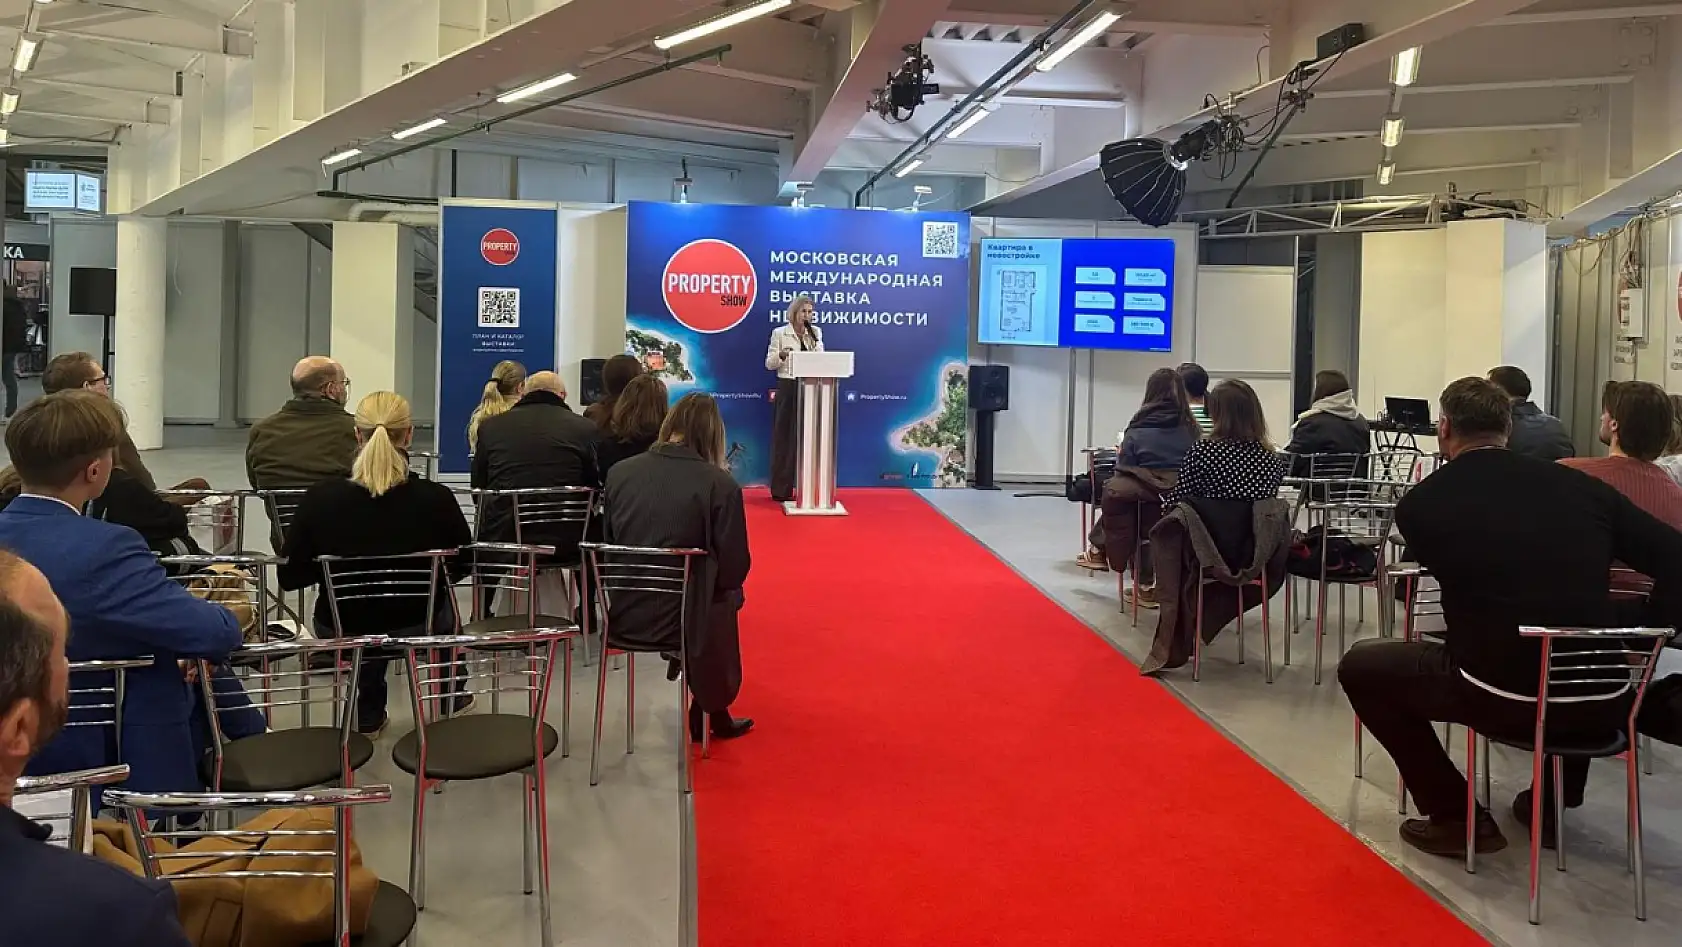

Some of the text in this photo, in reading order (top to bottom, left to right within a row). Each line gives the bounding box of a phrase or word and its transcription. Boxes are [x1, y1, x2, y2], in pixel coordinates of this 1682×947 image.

[484, 242, 517, 251] PROPERTY
[770, 250, 899, 267] МОСКОВСКАЯ
[668, 273, 751, 295] PROPERTY
[770, 270, 943, 288] МЕЖДУНАРОДНАЯ
[720, 294, 748, 307] SHOW
